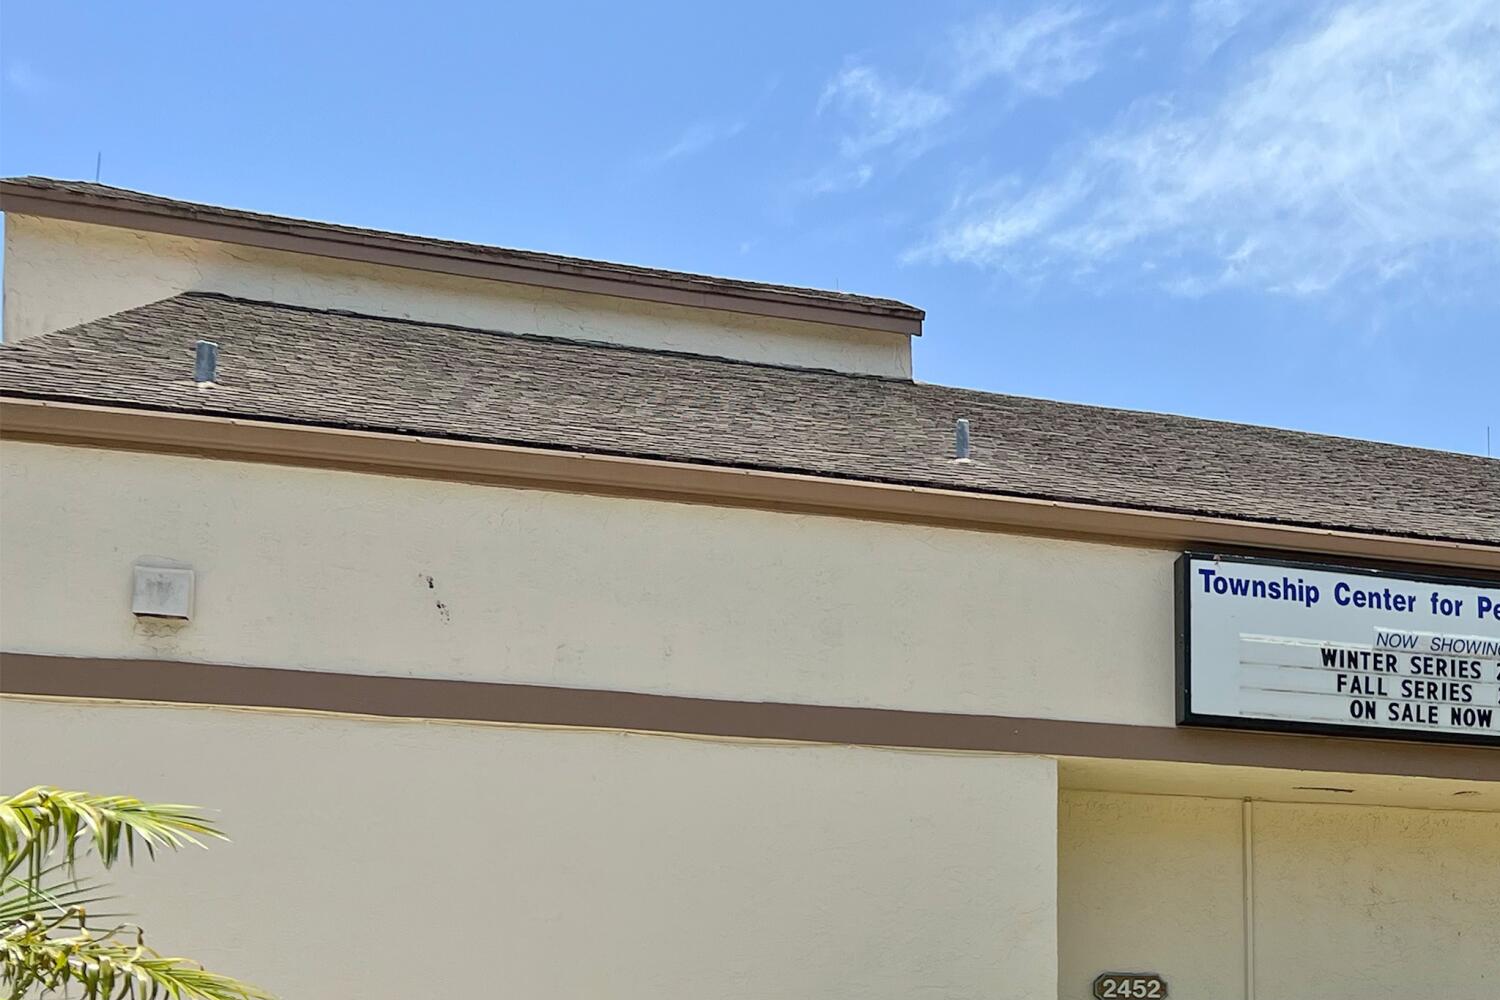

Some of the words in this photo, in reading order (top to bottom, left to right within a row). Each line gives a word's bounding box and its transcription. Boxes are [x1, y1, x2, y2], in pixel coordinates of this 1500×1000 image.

[1198, 568, 1320, 607] Township
[1334, 582, 1416, 612] Center
[1431, 592, 1463, 617] for
[1376, 632, 1419, 649] NOW
[1320, 648, 1398, 673] WINTER
[1410, 655, 1482, 679] SERIES
[1336, 673, 1388, 696] FALL
[1401, 679, 1473, 702] SERIES
[1350, 699, 1376, 719] ON
[1388, 702, 1439, 724] SALE
[1451, 707, 1492, 728] NOW
[1103, 979, 1161, 998] 2452
